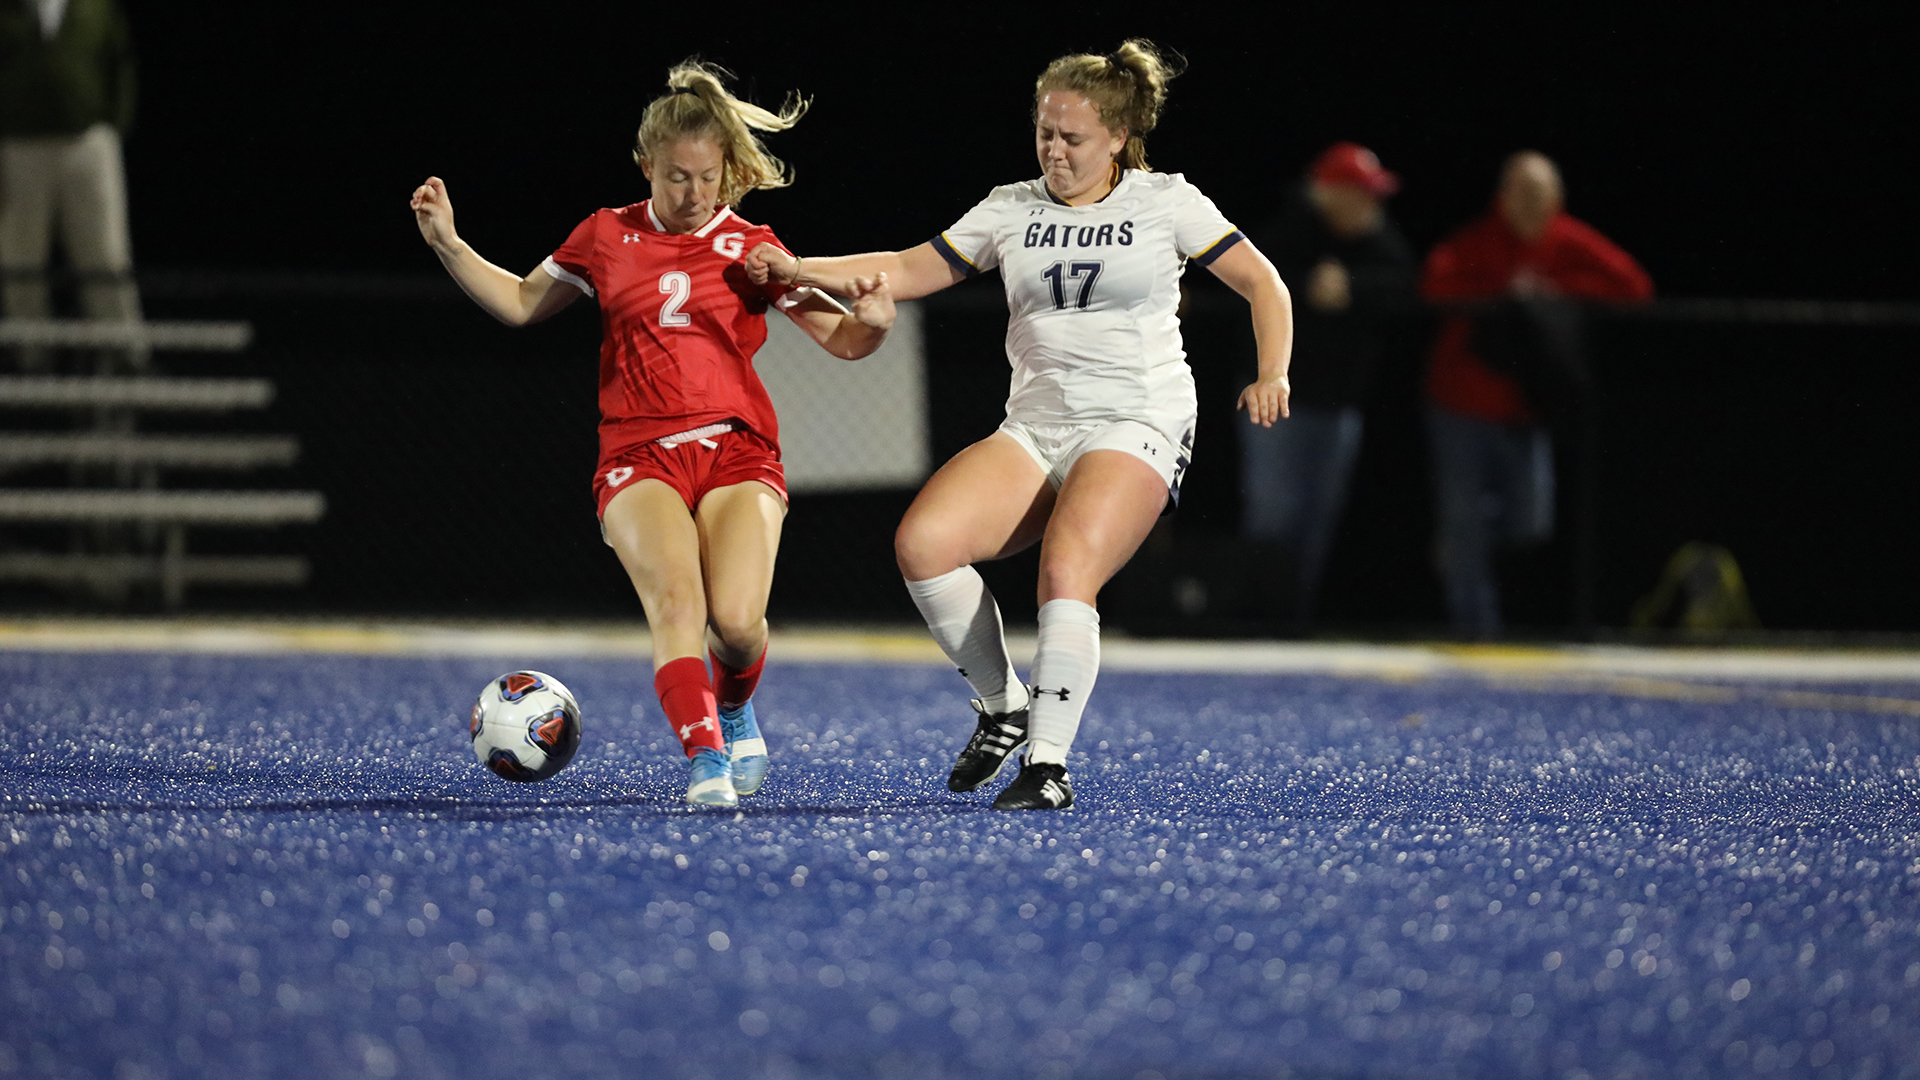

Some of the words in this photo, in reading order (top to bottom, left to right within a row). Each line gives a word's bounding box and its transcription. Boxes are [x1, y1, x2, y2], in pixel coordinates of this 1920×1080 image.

[712, 232, 746, 259] G
[1024, 220, 1134, 248] GATORS
[658, 271, 691, 327] 2
[1040, 260, 1105, 310] 17
